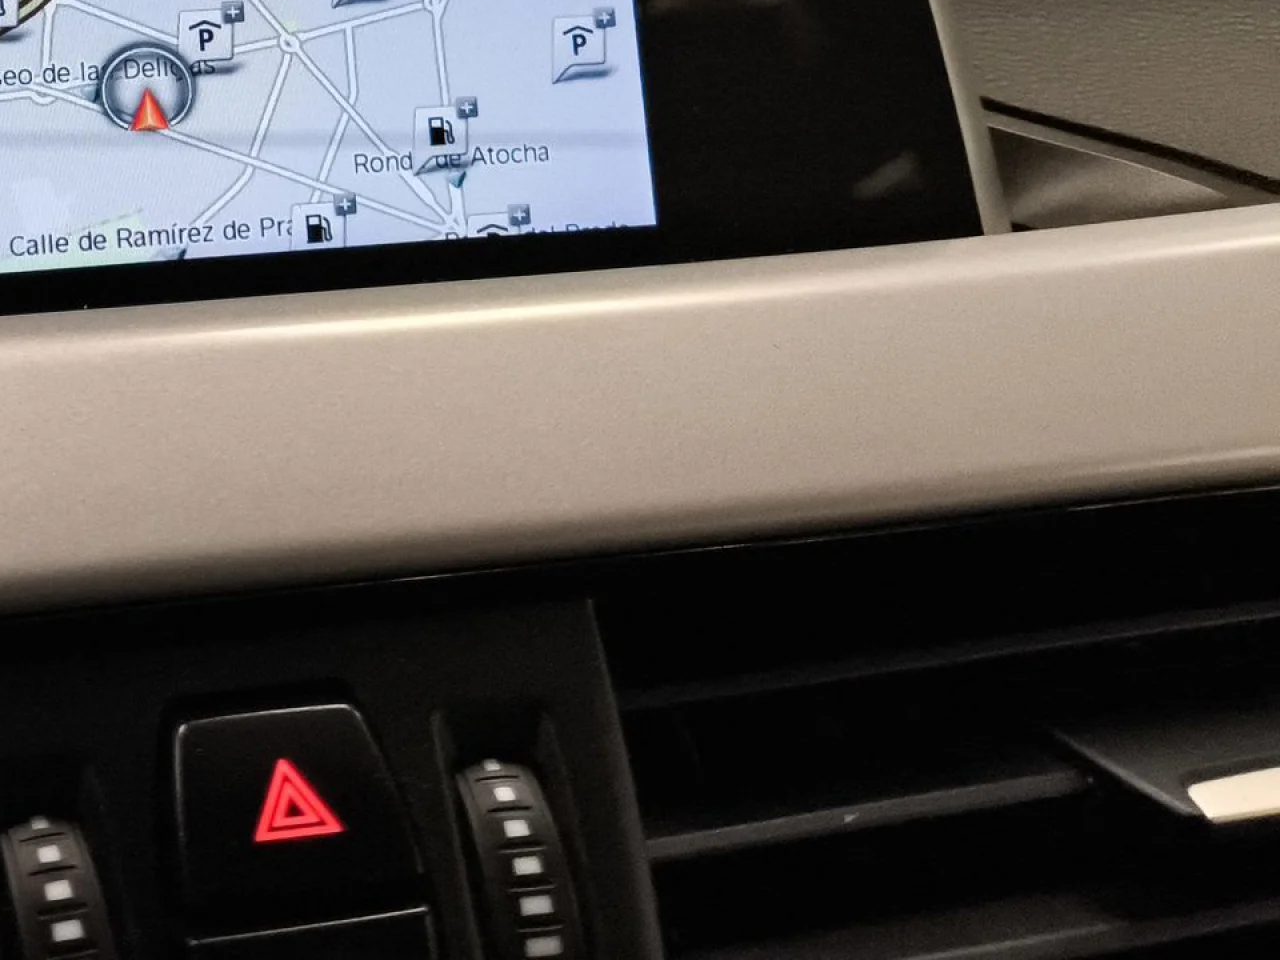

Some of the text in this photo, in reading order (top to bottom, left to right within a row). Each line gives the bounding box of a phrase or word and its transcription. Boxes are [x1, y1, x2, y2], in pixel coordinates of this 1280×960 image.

[42, 63, 71, 84] de
[354, 151, 413, 174] Rond
[470, 143, 550, 167] Atocha
[9, 232, 69, 257] Calle
[78, 231, 107, 252] de
[116, 222, 213, 250] Ramírez
[223, 220, 251, 241] de
